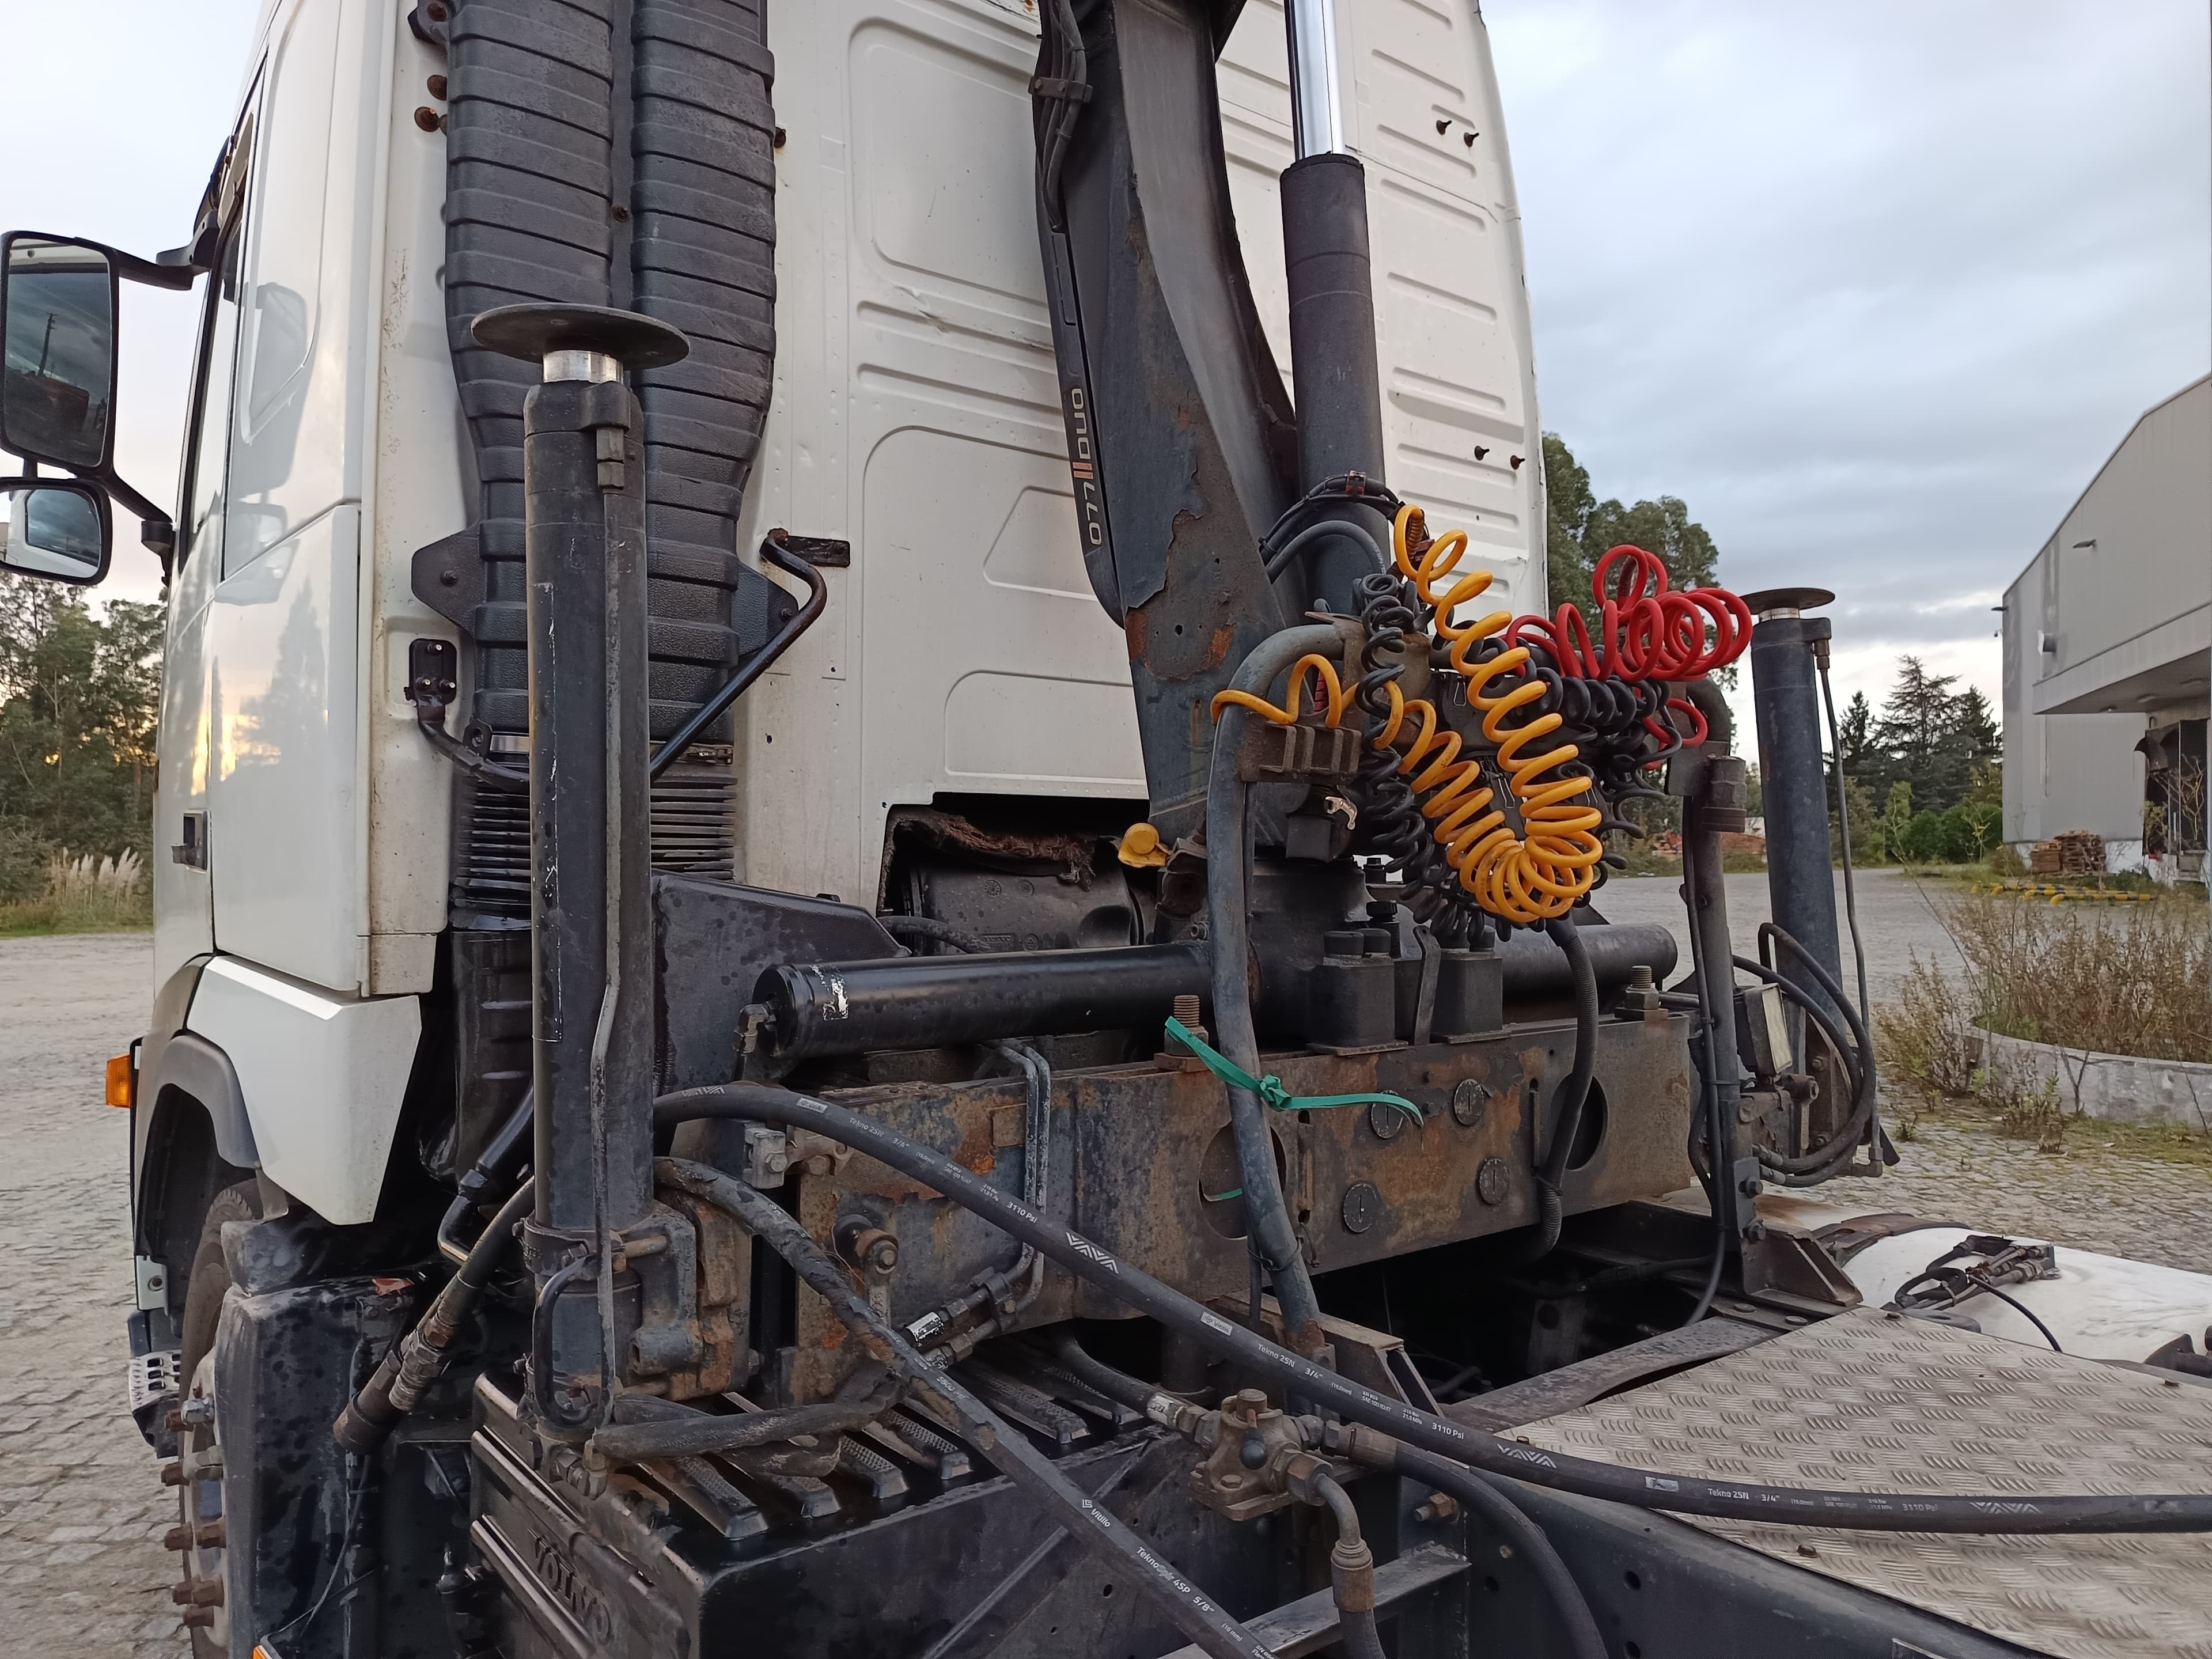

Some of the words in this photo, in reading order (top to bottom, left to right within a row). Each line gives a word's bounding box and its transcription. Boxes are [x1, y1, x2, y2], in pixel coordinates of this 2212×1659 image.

[1071, 388, 1092, 460] DUO
[1083, 482, 1102, 546] 077
[849, 1117, 869, 1130] Tekno
[1006, 1201, 1025, 1216] 3110
[1257, 1343, 1279, 1359] Tekno
[1279, 1354, 1296, 1368] 2SN
[1431, 1422, 1452, 1435] 3110
[1707, 1487, 1732, 1498] Tekno
[1733, 1491, 1749, 1499] 2SN
[1902, 1503, 1925, 1512] 3110
[1091, 1508, 1111, 1527] Vitillo
[1137, 1546, 1175, 1581] TeknoSpir
[1173, 1579, 1191, 1593] 4SP
[1256, 1645, 1265, 1653] EN
